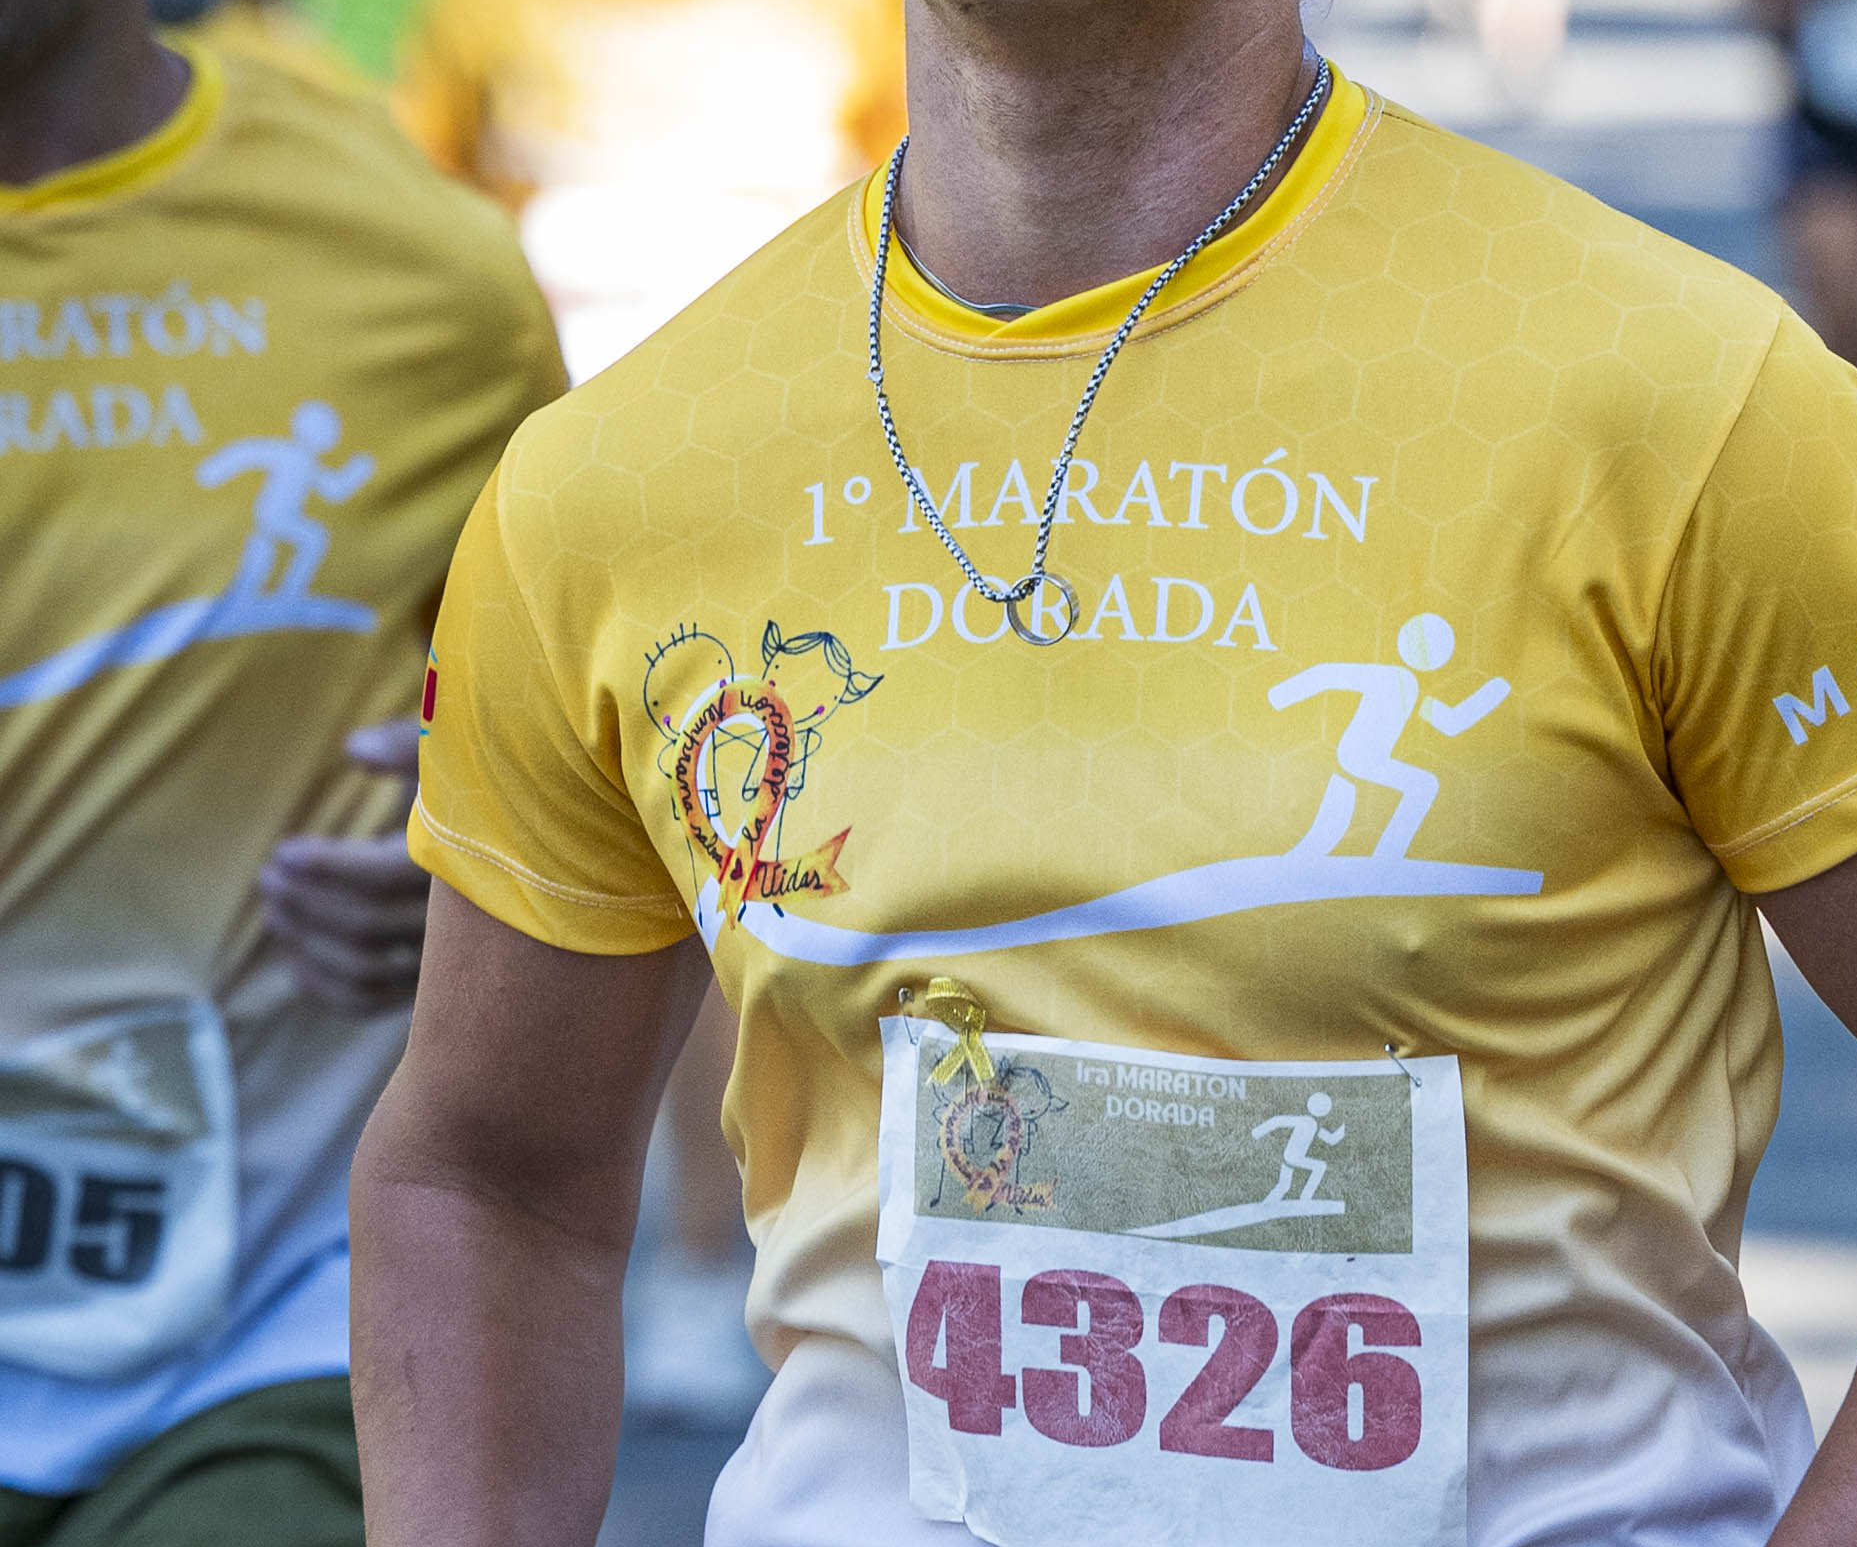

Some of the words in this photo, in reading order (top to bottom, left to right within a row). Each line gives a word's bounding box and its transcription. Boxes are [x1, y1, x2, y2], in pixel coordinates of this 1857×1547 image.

[898, 448, 1379, 543] MARATÓN
[880, 573, 1278, 652] DORADA
[1106, 1094, 1217, 1129] DORADA
[1116, 1064, 1248, 1101] MARATON
[905, 1260, 1423, 1471] 4326
